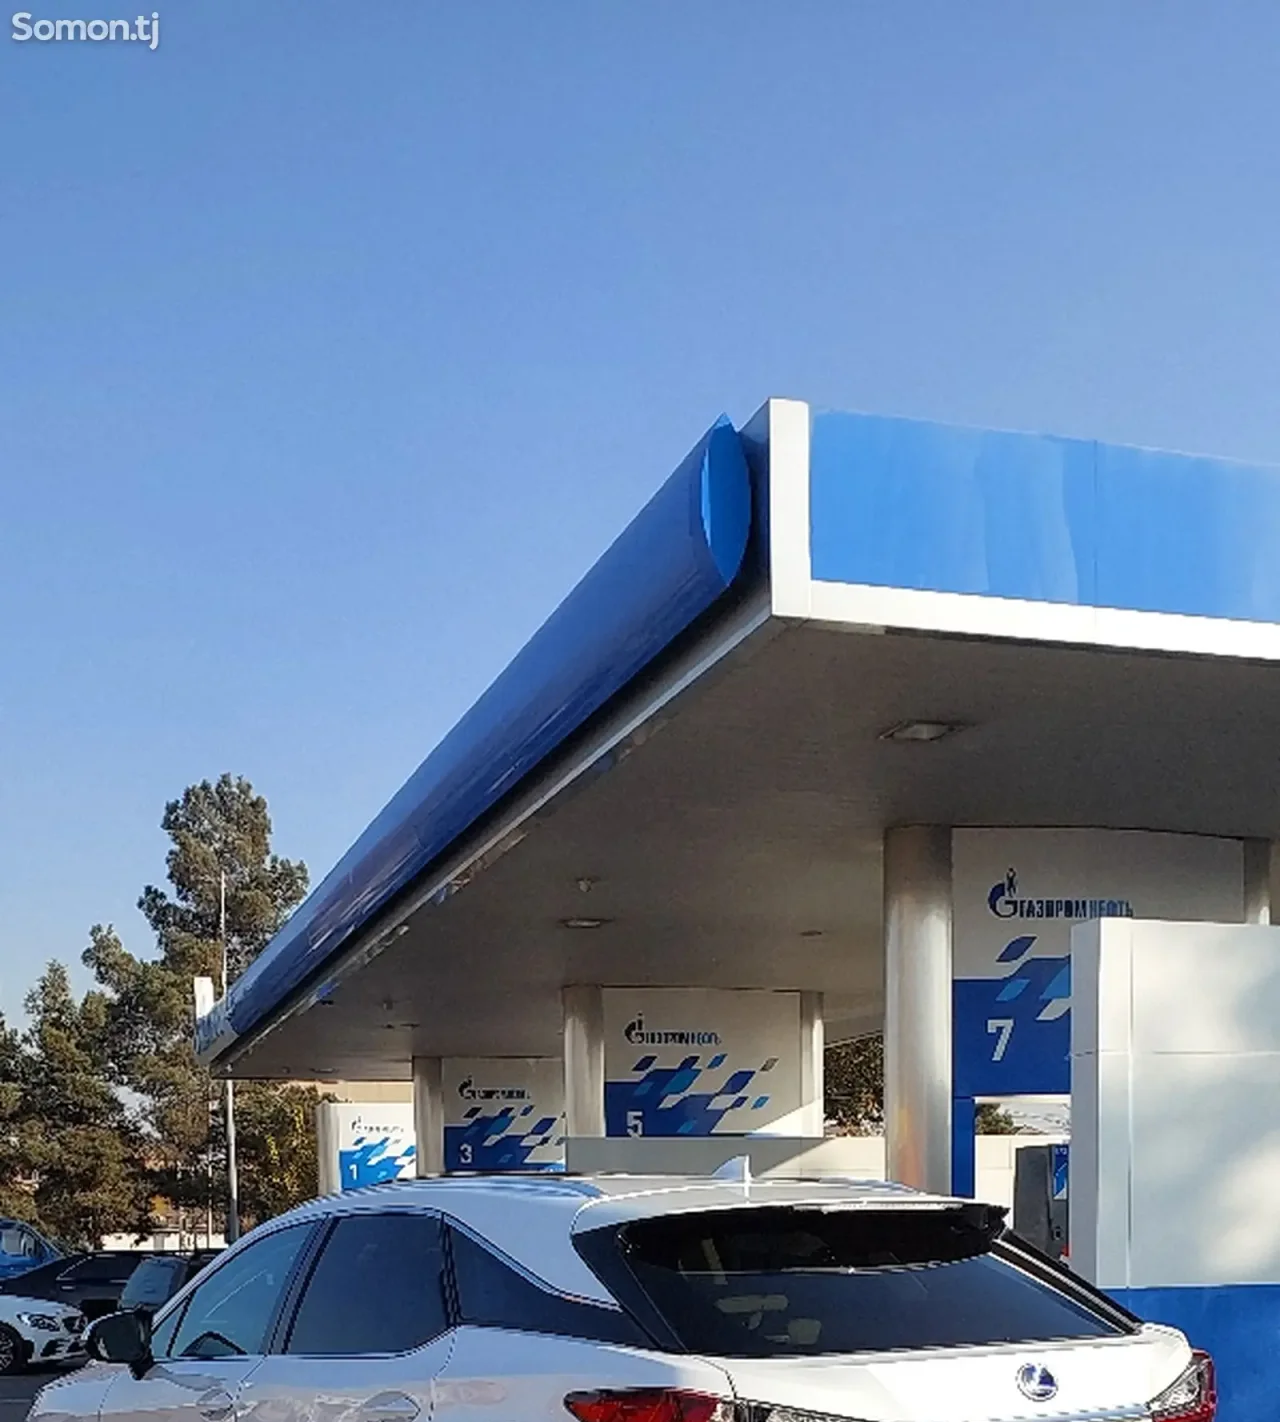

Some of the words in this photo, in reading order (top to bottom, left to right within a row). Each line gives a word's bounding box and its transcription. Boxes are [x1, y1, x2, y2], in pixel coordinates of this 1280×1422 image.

[987, 1018, 1015, 1062] 7
[627, 1110, 643, 1139] 5
[460, 1143, 473, 1164] 3
[349, 1163, 358, 1181] 1
